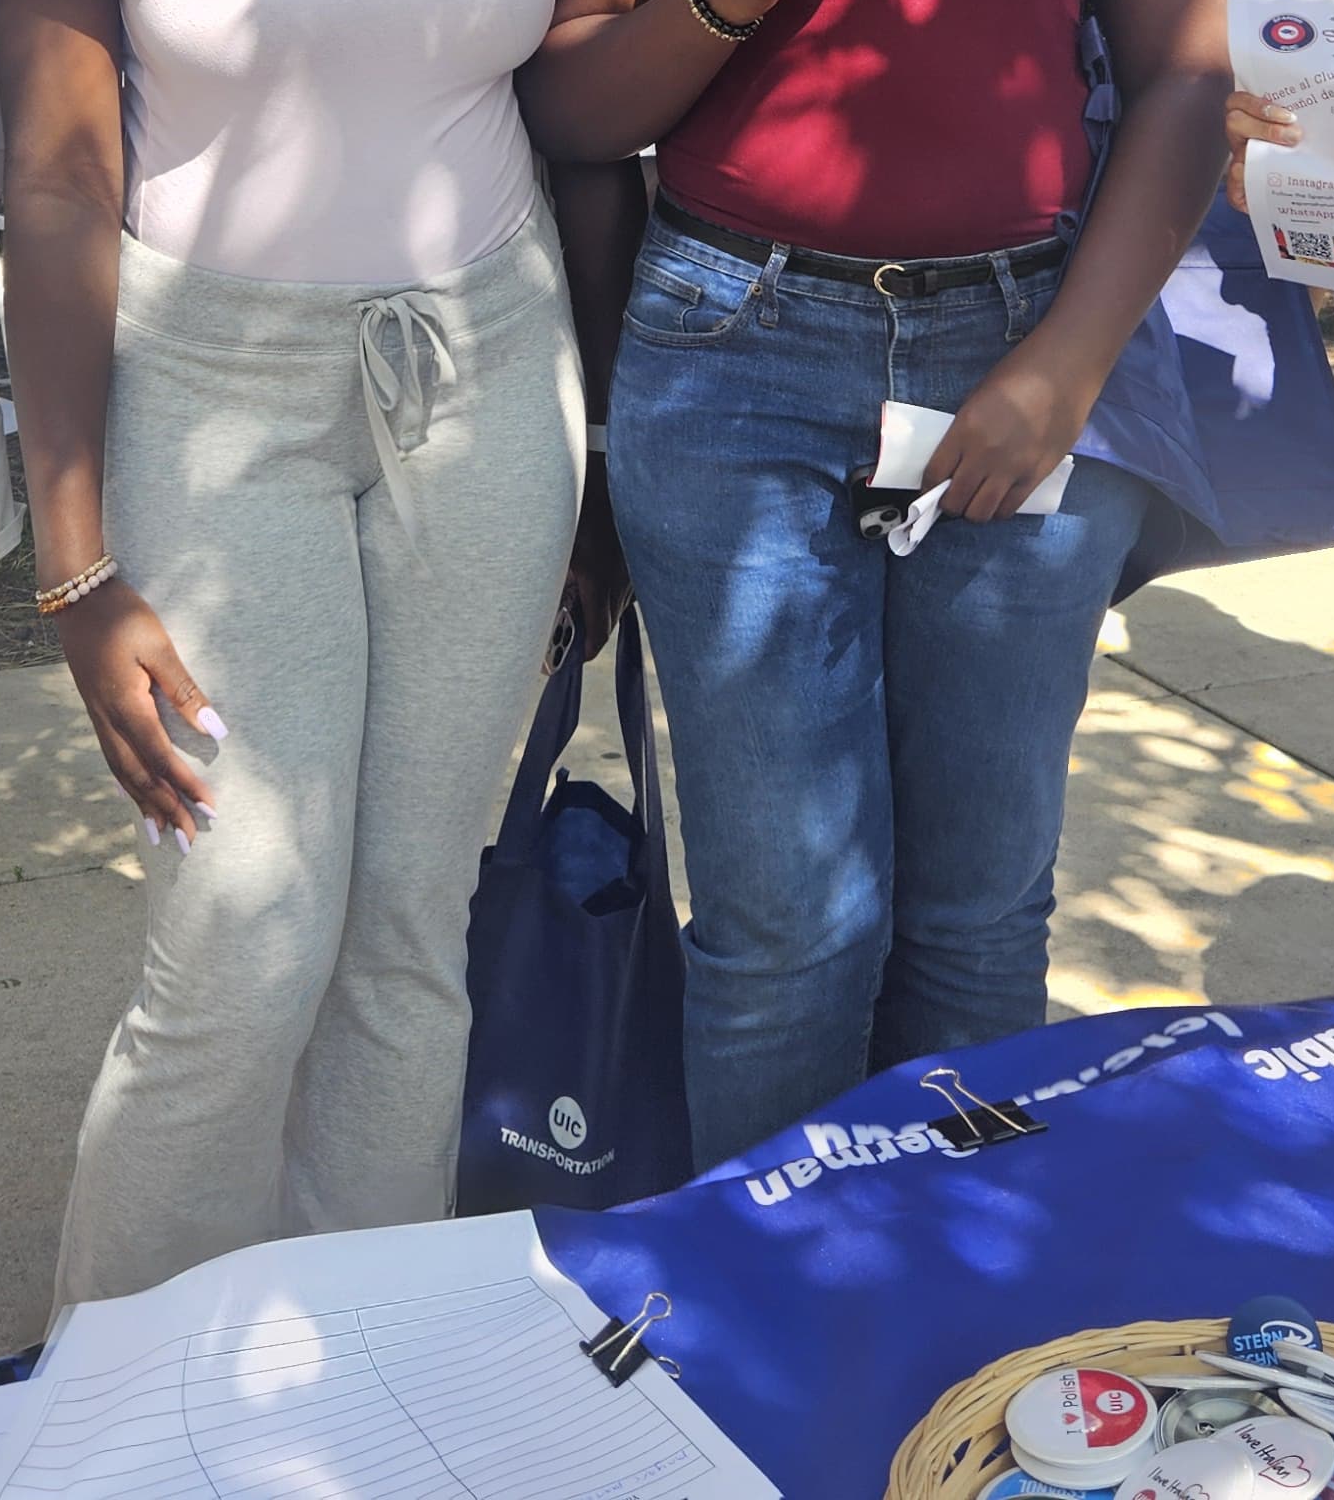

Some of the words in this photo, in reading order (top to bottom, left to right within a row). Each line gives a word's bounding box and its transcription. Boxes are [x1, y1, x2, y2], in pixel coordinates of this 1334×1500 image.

[1322, 89, 1334, 101] de
[554, 1108, 582, 1138] UIC
[500, 1127, 615, 1175] TRANSPORTATION
[1233, 1330, 1283, 1351] STERN
[1062, 1373, 1078, 1409] Polish
[1109, 1391, 1122, 1412] UIC
[1237, 1427, 1258, 1450] love
[1255, 1444, 1291, 1479] Italian
[1151, 1470, 1168, 1488] love
